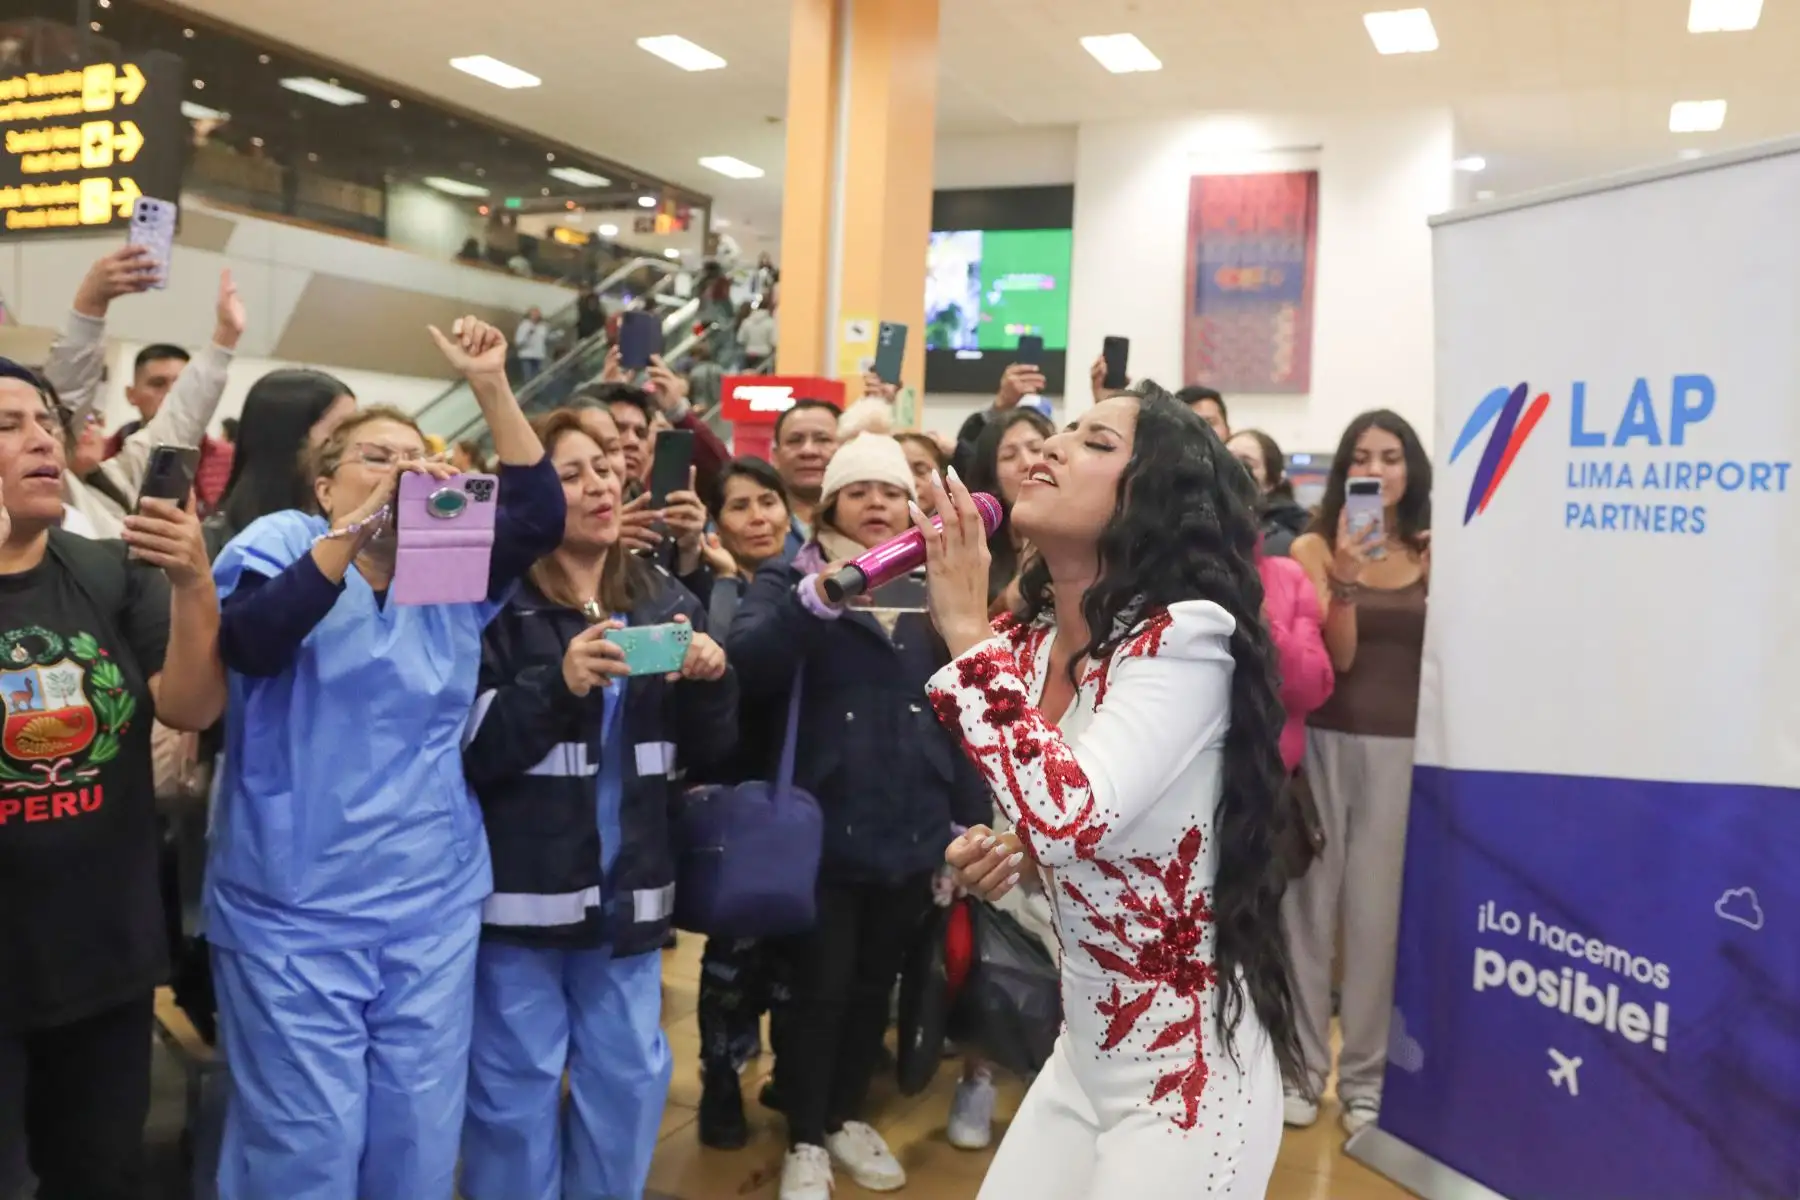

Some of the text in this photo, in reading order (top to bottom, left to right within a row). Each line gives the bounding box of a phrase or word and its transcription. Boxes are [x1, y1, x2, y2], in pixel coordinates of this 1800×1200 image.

[1570, 374, 1716, 447] LAP
[1567, 461, 1792, 492] LIMA AIRPORT
[1565, 503, 1707, 534] PARTNERS
[0, 784, 104, 825] PERU
[1478, 900, 1670, 990] ¡Lo hacemos
[1473, 947, 1670, 1053] posible!
